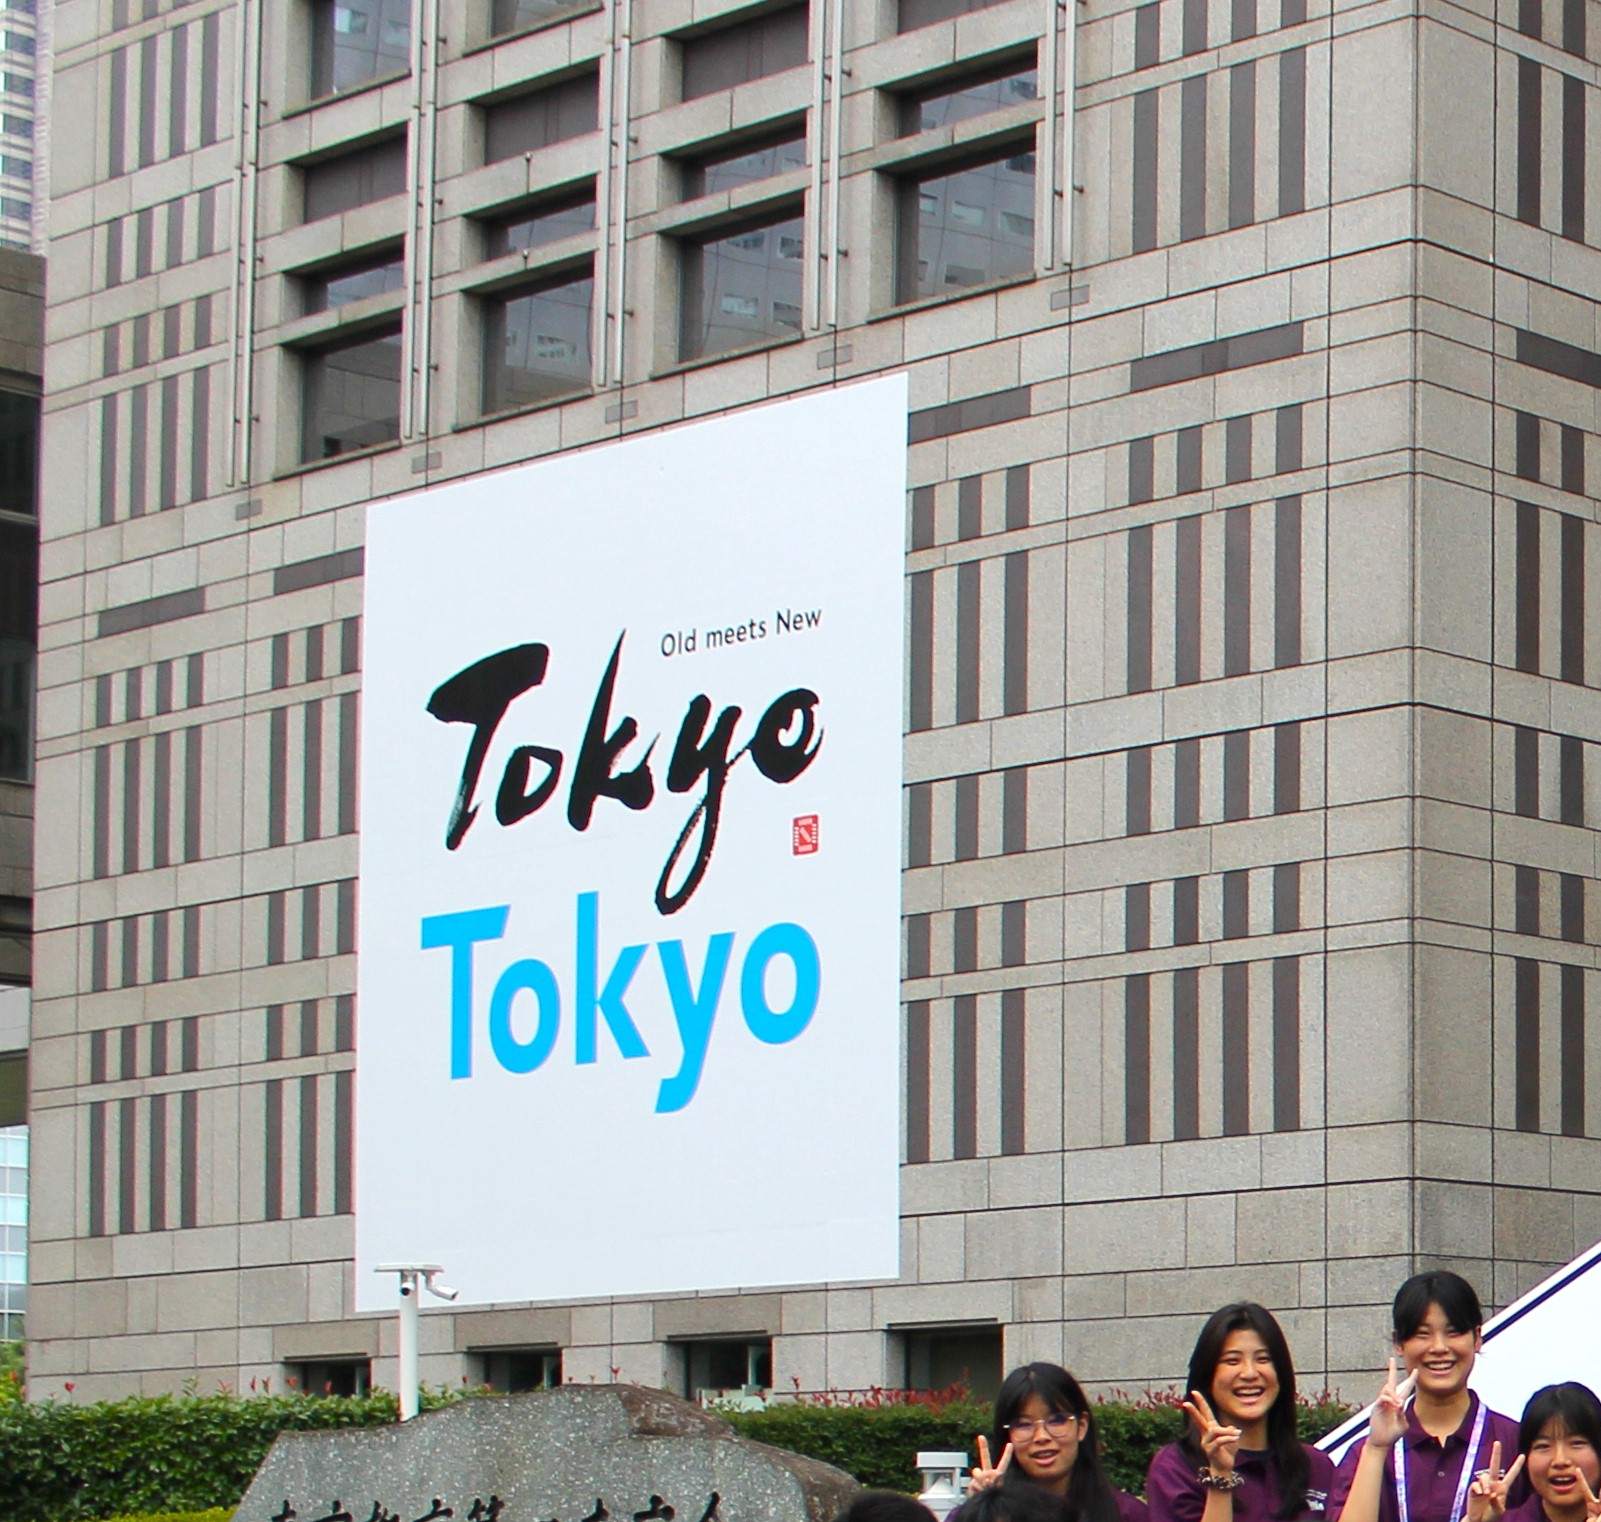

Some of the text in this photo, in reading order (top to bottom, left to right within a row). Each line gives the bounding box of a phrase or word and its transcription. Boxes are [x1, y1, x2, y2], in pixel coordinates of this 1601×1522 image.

[660, 607, 824, 658] Old meets New
[426, 628, 825, 917] Tokyo
[421, 891, 822, 1115] Tokyo
